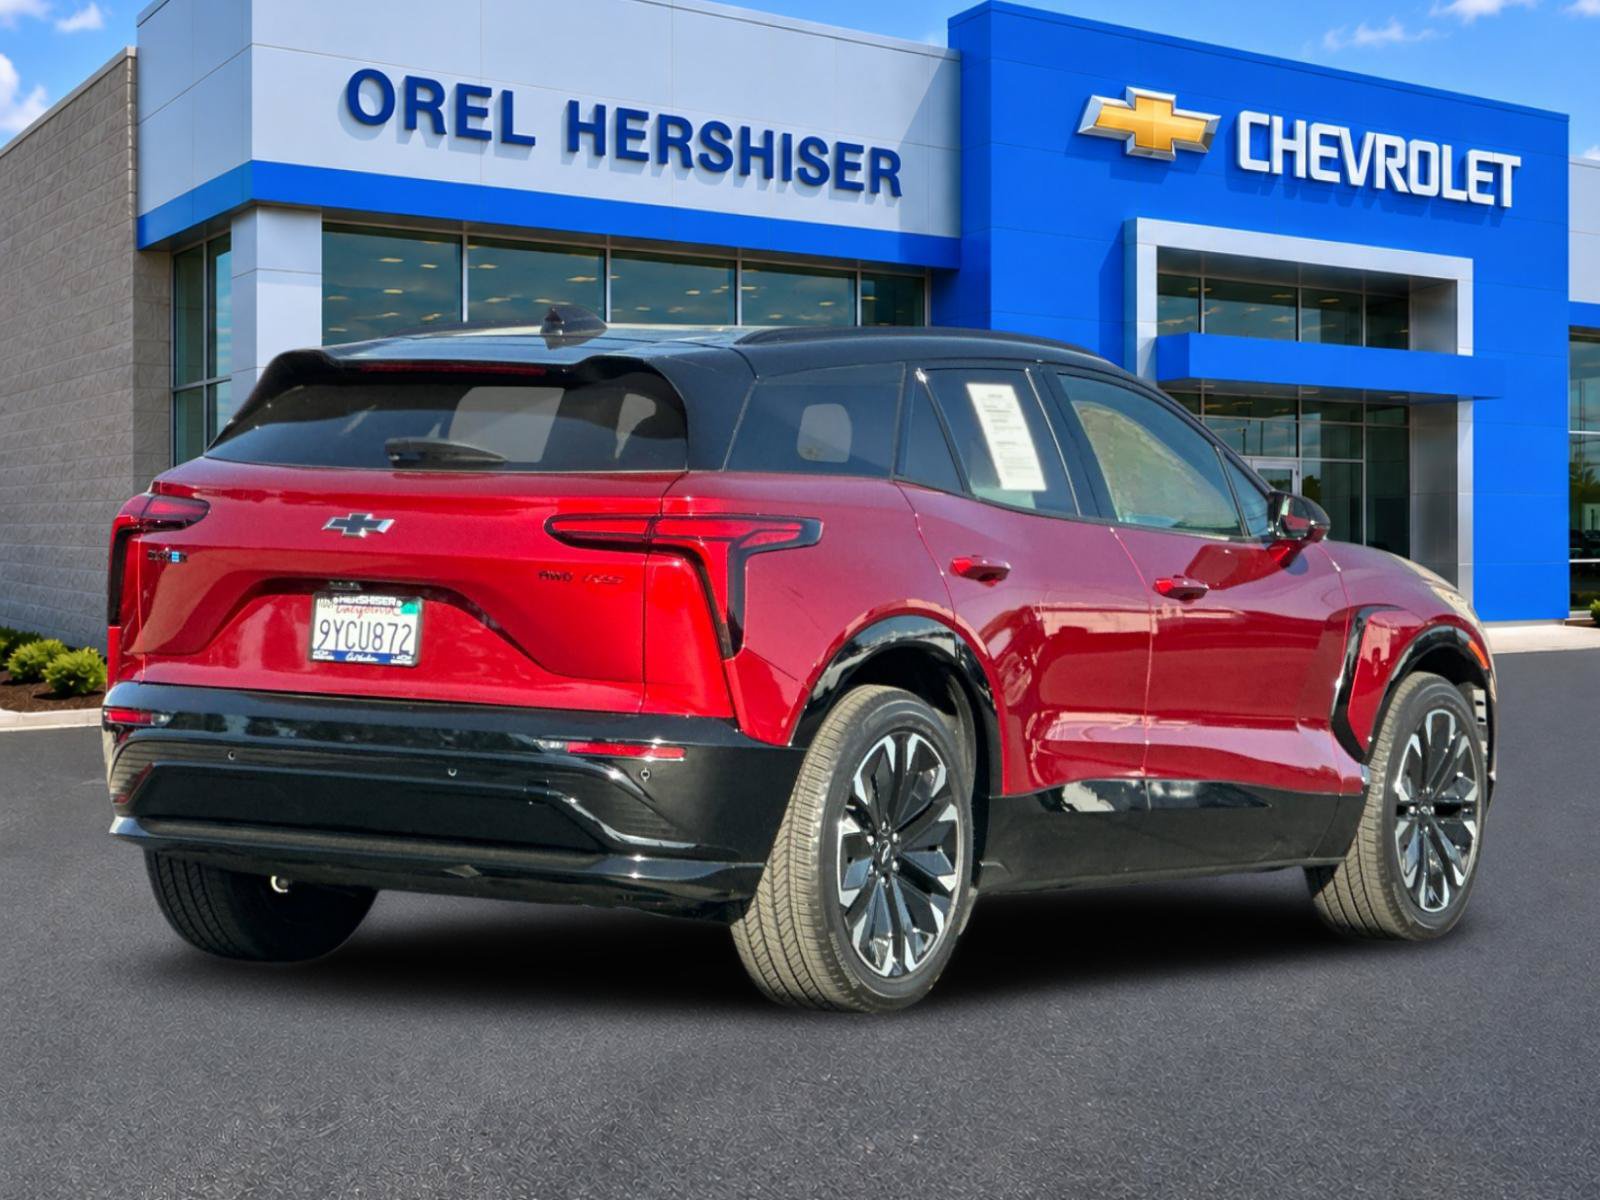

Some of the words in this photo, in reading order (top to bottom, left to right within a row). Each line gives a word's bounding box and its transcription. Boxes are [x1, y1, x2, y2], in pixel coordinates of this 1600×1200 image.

[346, 68, 536, 147] OREL
[566, 99, 902, 197] HERSHISER
[1236, 110, 1522, 208] CHEVROLET
[317, 619, 412, 655] 9YCU872
